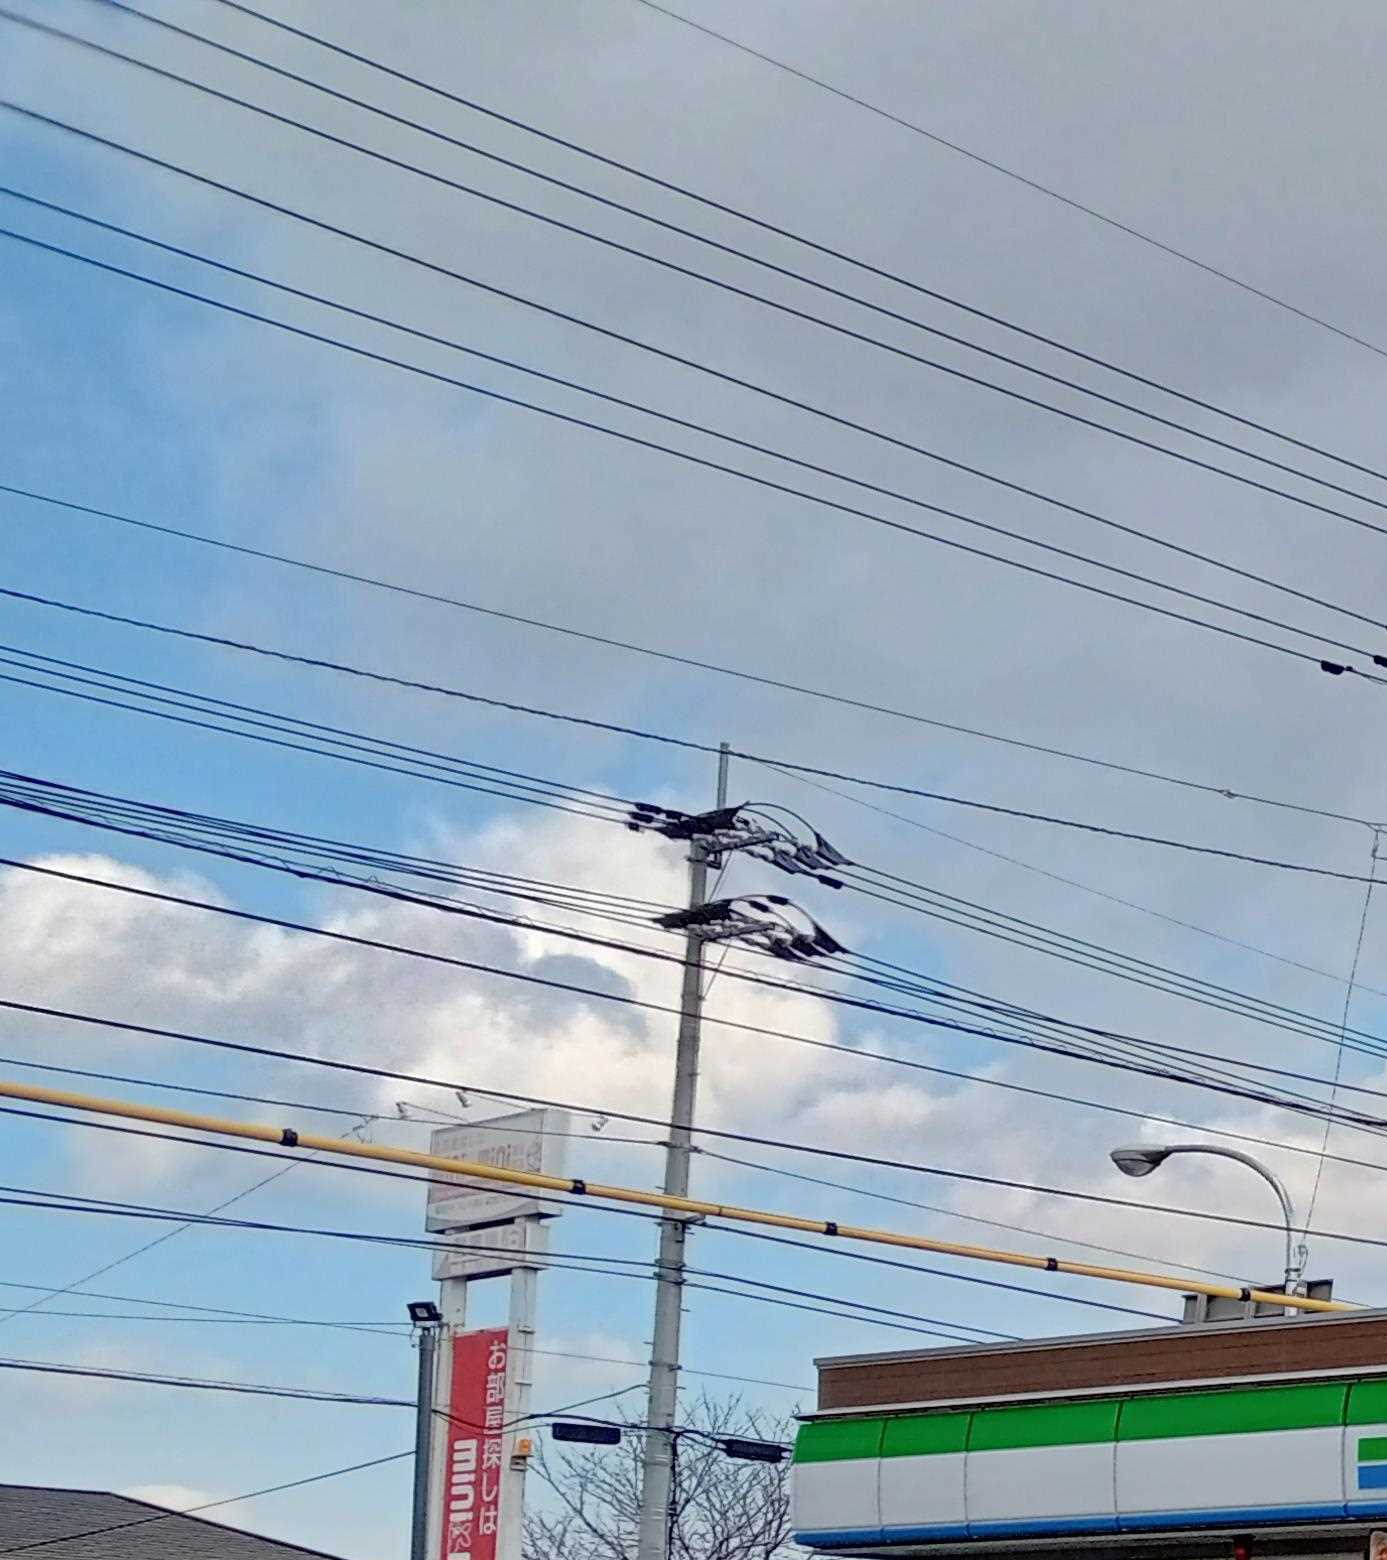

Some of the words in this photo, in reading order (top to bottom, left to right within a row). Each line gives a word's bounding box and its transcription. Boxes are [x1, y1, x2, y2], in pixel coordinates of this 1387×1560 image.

[449, 1438, 478, 1521] mini
[478, 1340, 506, 1536] お部屋探しは
